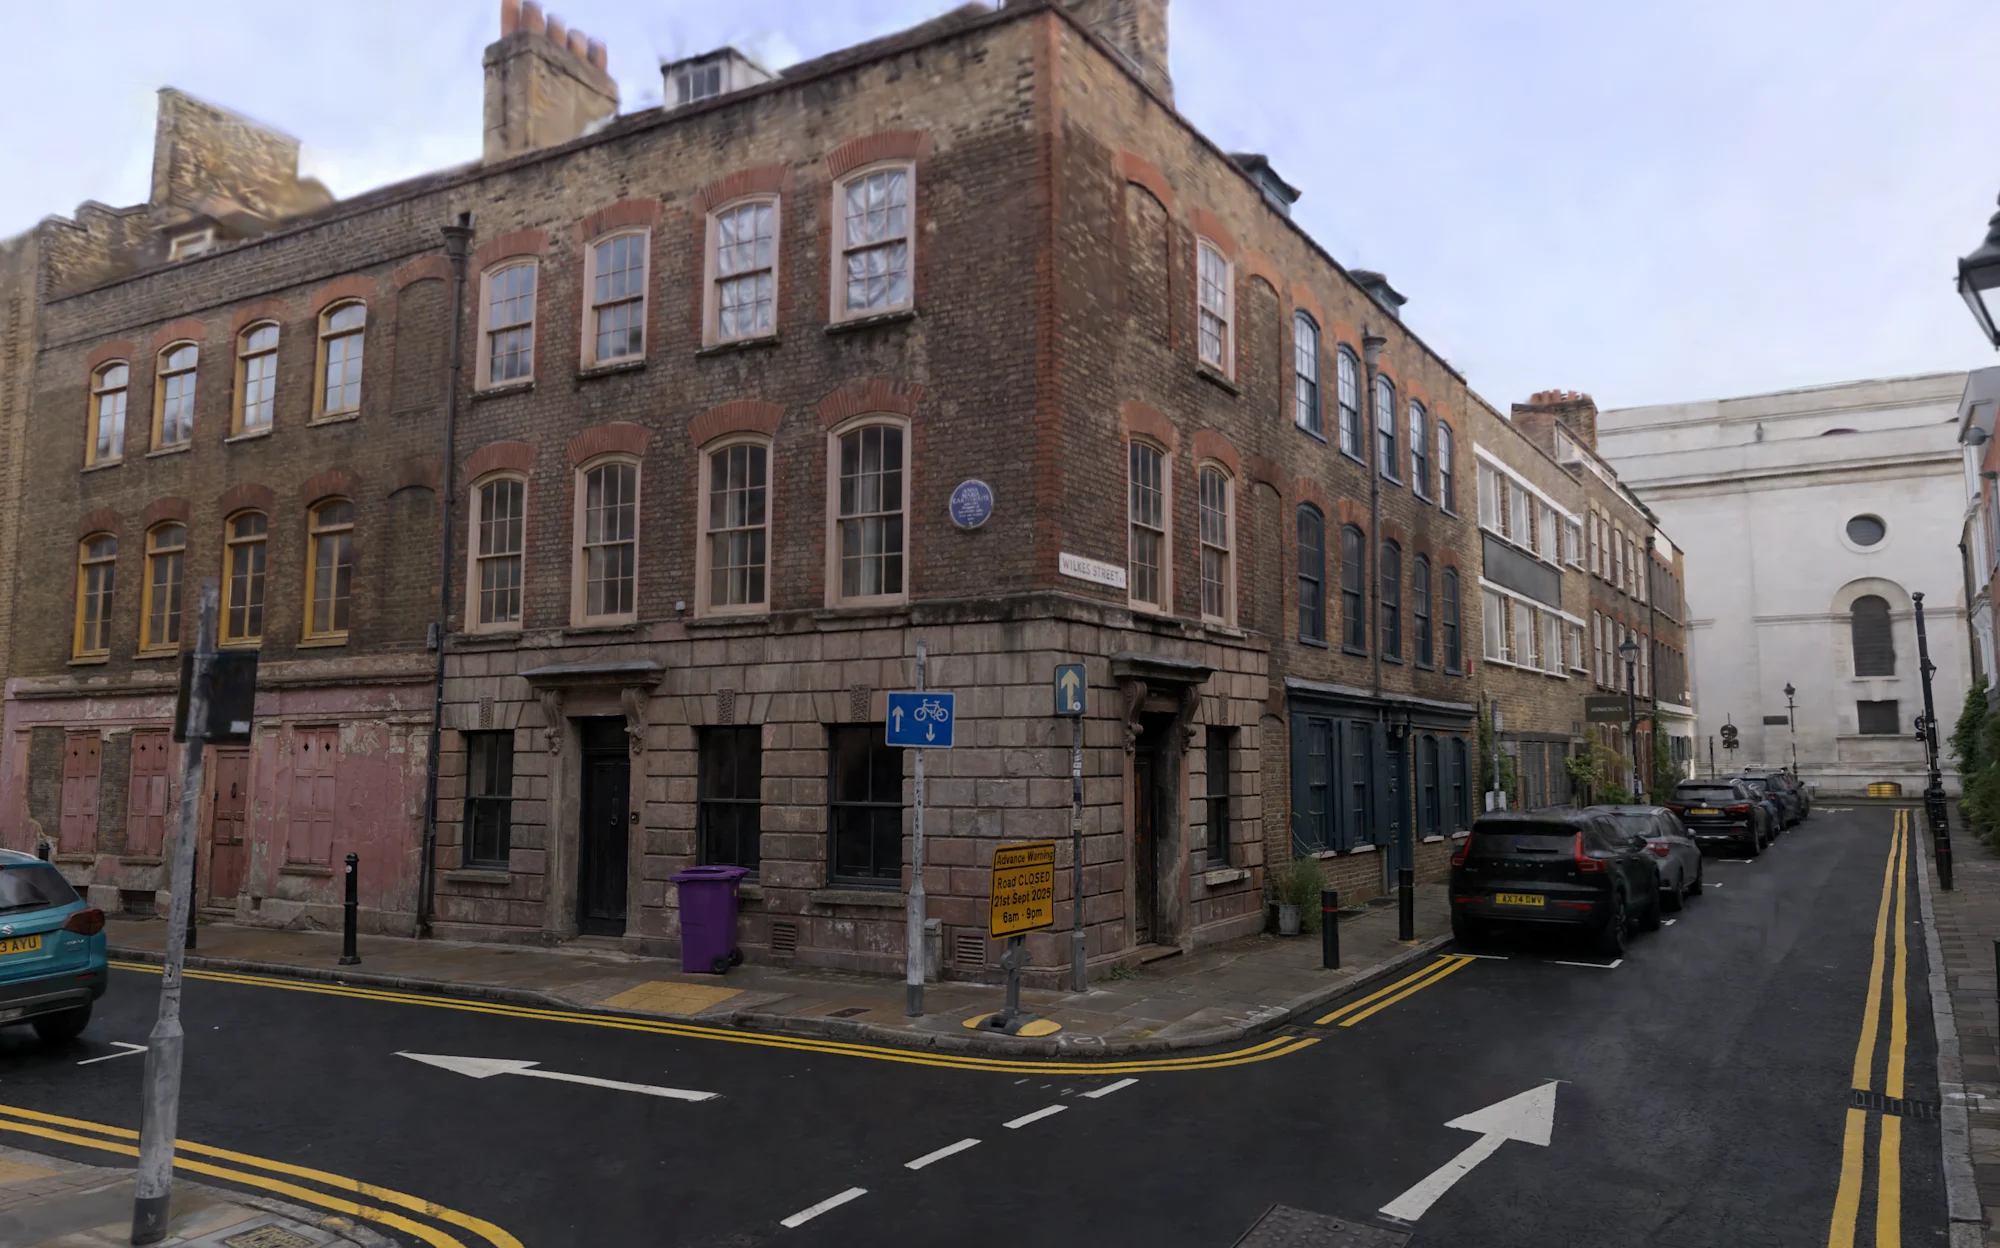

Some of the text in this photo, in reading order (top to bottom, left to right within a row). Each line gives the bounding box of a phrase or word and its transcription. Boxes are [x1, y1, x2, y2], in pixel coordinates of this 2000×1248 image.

[1063, 558, 1090, 575] WILKES
[1093, 565, 1118, 581] STREET
[997, 849, 1053, 865] Advance Warning
[998, 871, 1050, 889] Road CLOSED
[994, 888, 1051, 907] 21st Sept 2025
[1003, 911, 1019, 923] 6am
[1026, 907, 1042, 920] 9pm
[12, 937, 37, 951] AYU
